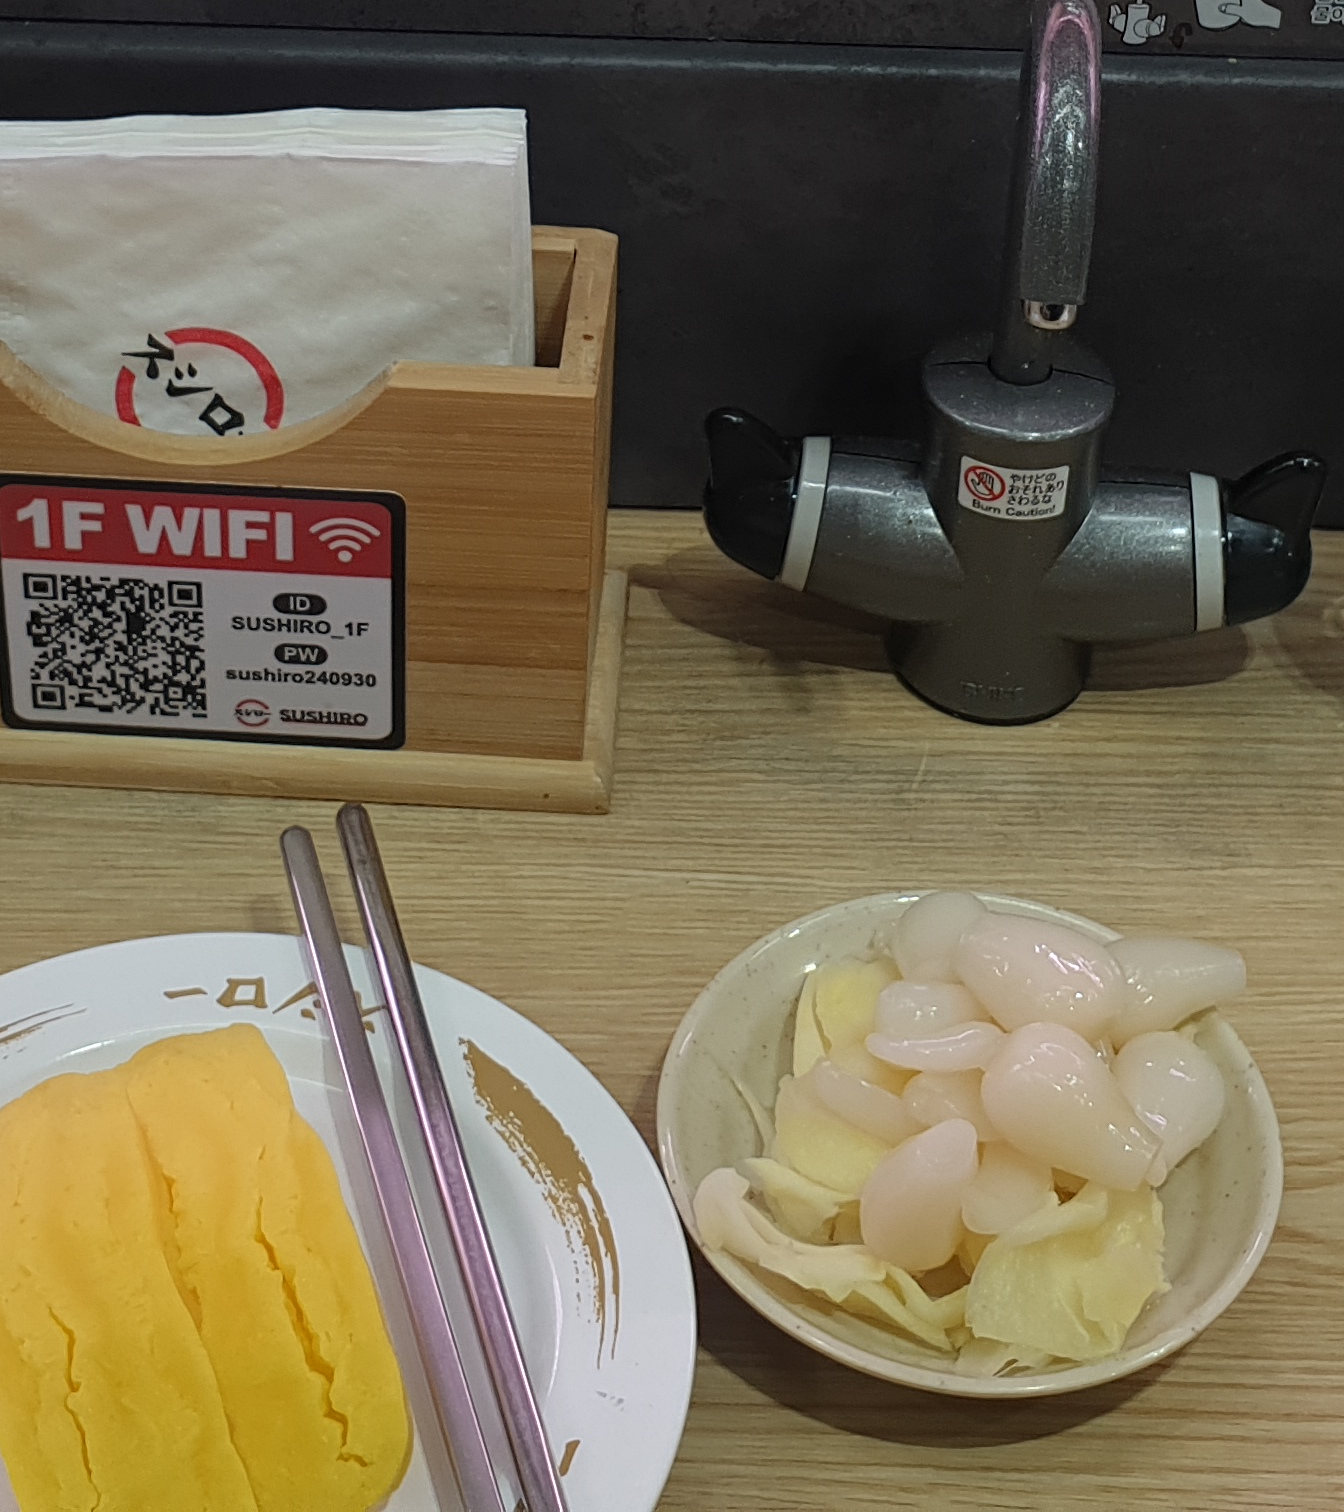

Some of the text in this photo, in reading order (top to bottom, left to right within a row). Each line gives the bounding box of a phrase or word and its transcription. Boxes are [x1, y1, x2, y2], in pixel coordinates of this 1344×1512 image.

[121, 333, 245, 437] スシロ
[1010, 472, 1056, 485] やけどの
[972, 499, 1056, 518] Burn Caution!
[1007, 494, 1053, 506] さわるな
[16, 498, 295, 563] 1F WIFI
[287, 595, 312, 613] ID
[231, 616, 370, 640] SUSHIRO_1F
[283, 646, 320, 663] PW
[226, 666, 377, 689] sushiro240930
[280, 707, 369, 728] SUSHIRO
